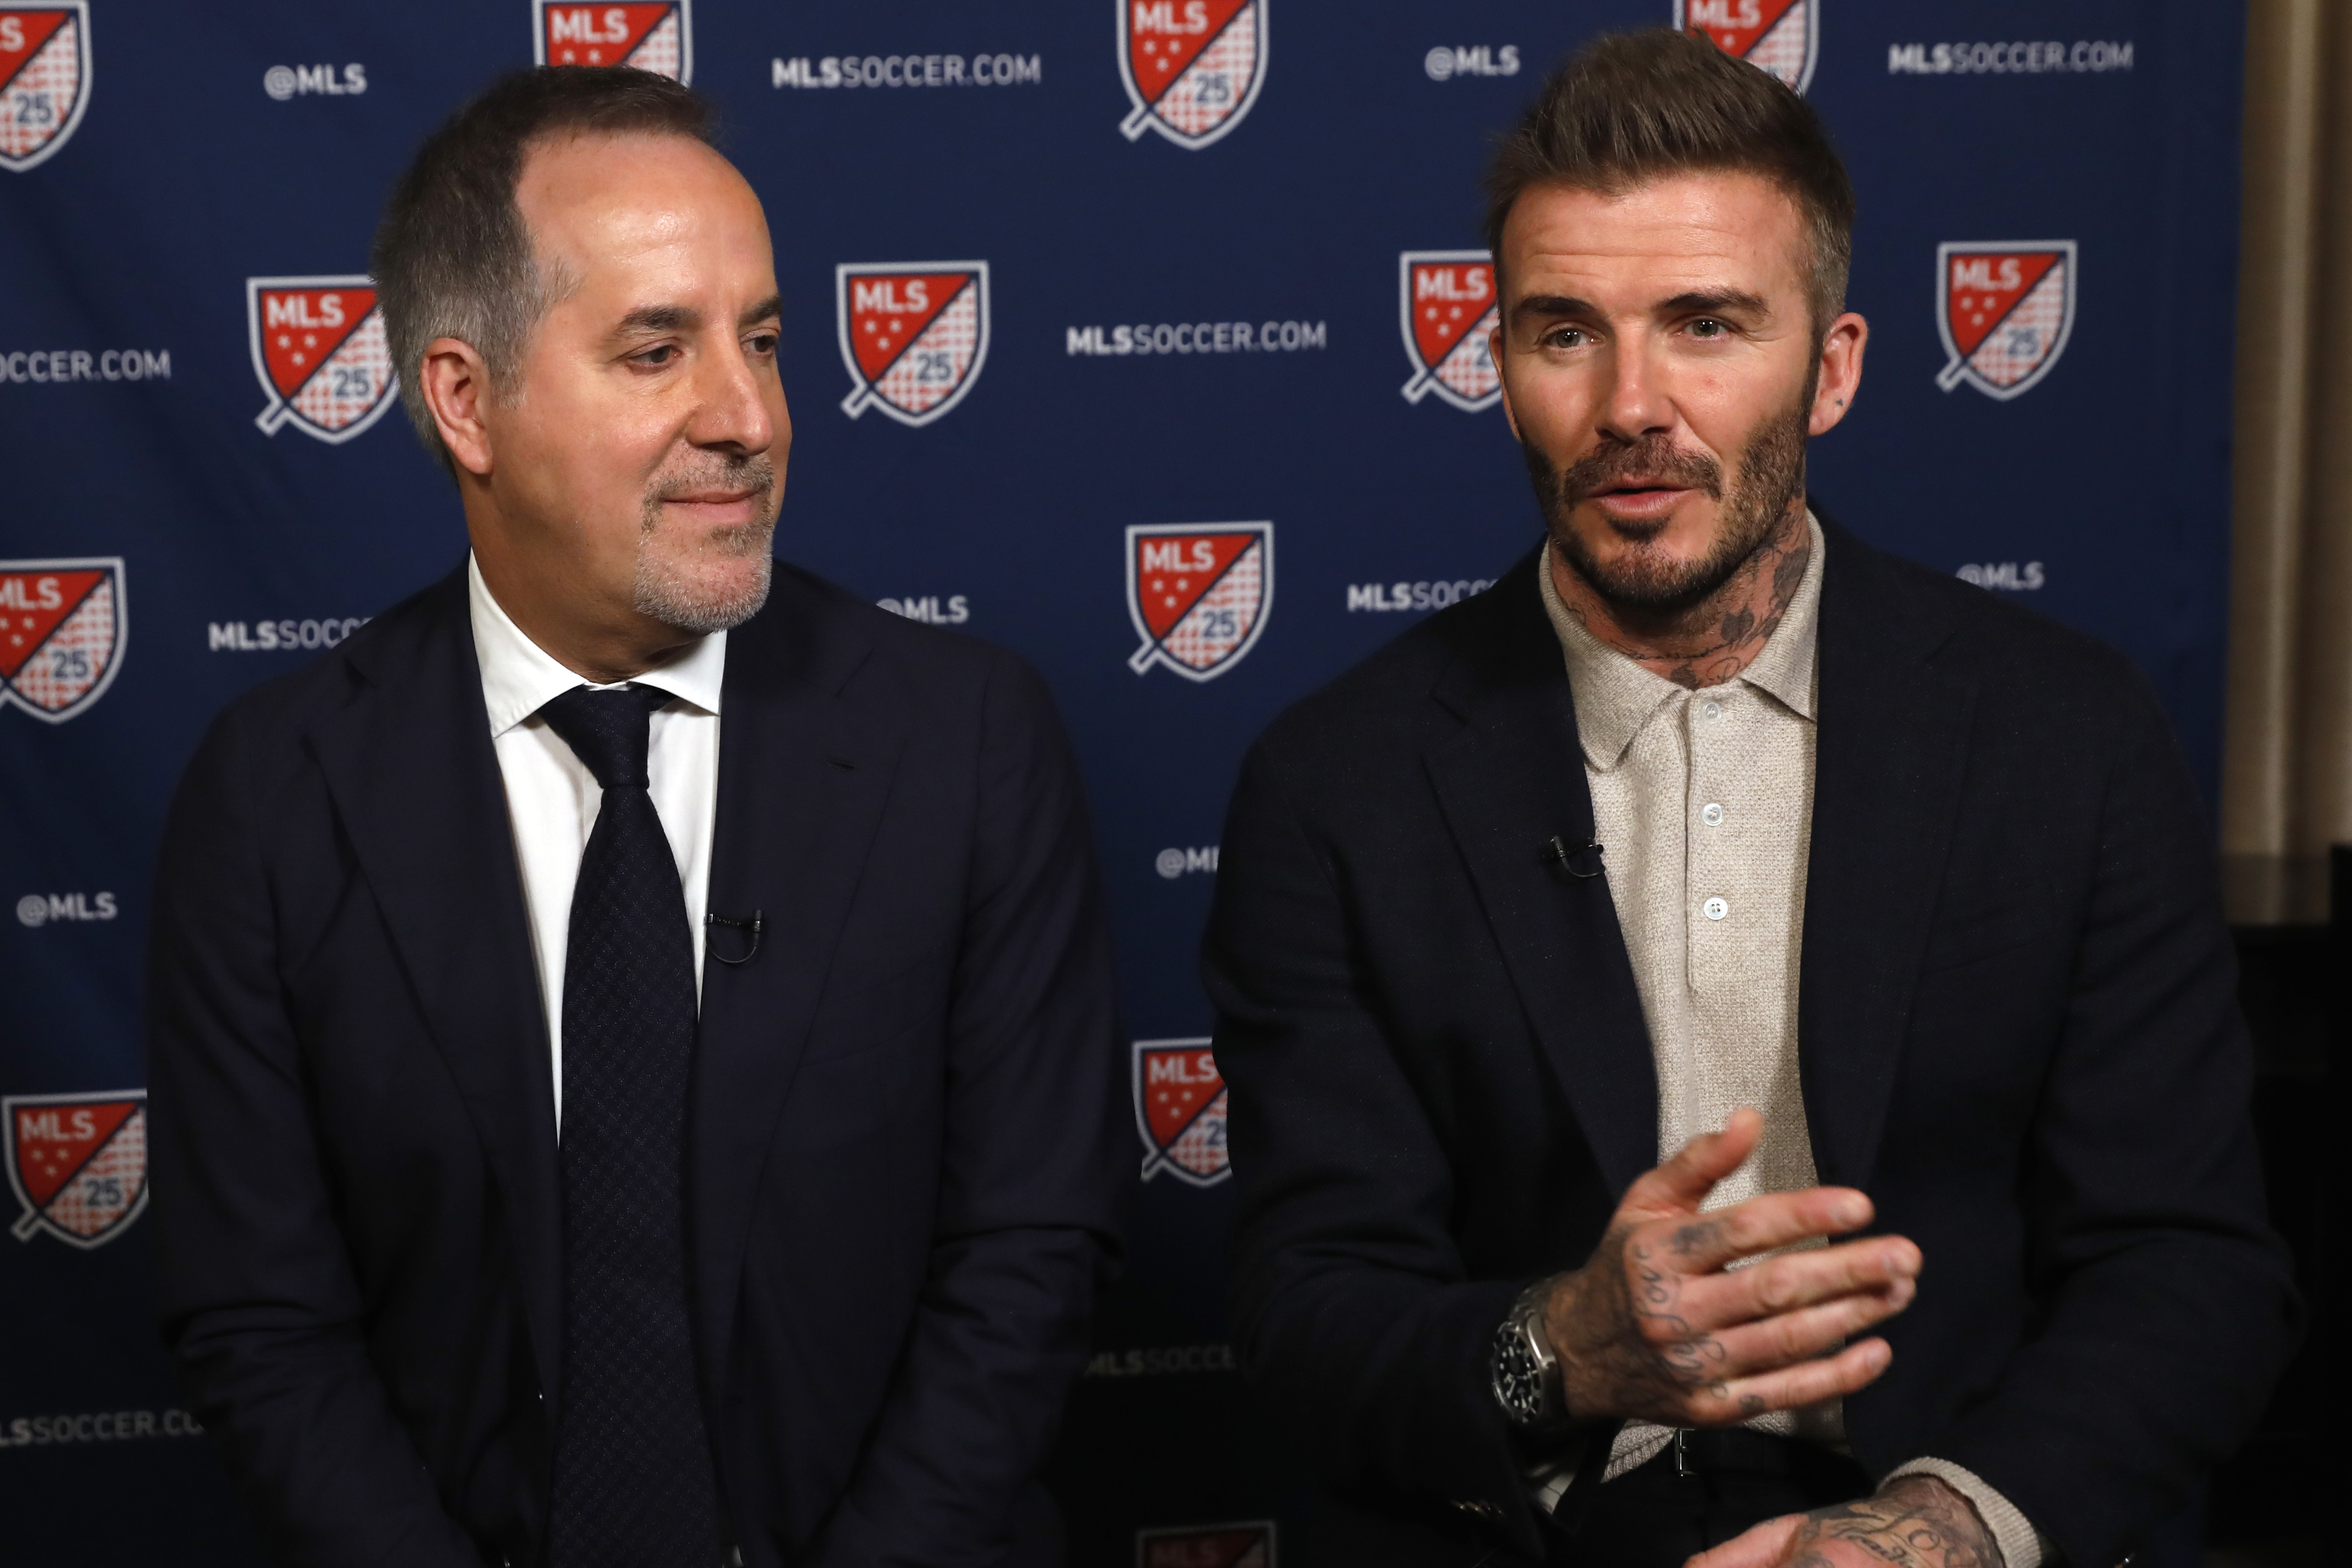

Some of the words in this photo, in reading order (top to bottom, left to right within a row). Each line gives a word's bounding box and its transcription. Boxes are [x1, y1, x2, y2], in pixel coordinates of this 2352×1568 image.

[551, 8, 629, 44] MLS
[1134, 1, 1209, 35] MLS
[1690, 0, 1761, 29] MLS
[771, 53, 1041, 89] MLSSOCCER.COM
[1424, 45, 1521, 82] @MLS
[1887, 41, 2134, 74] MLSSOCCER.COM
[264, 63, 367, 100] @MLS
[1196, 73, 1230, 103] 25
[15, 94, 53, 124] 25
[1417, 267, 1490, 303] MLS
[1952, 257, 2022, 292] MLS
[266, 293, 345, 328] MLS
[855, 279, 929, 314] MLS
[1066, 320, 1327, 356] MLSSOCCER.COM
[333, 368, 370, 399] 25
[917, 352, 952, 383] 25
[1143, 539, 1216, 572] MLS
[1202, 609, 1236, 638] 25
[52, 650, 89, 680] 25
[16, 891, 118, 927] @MLS
[1149, 1054, 1219, 1085] MLS
[19, 1109, 96, 1142] MLS
[84, 1177, 122, 1207] 25
